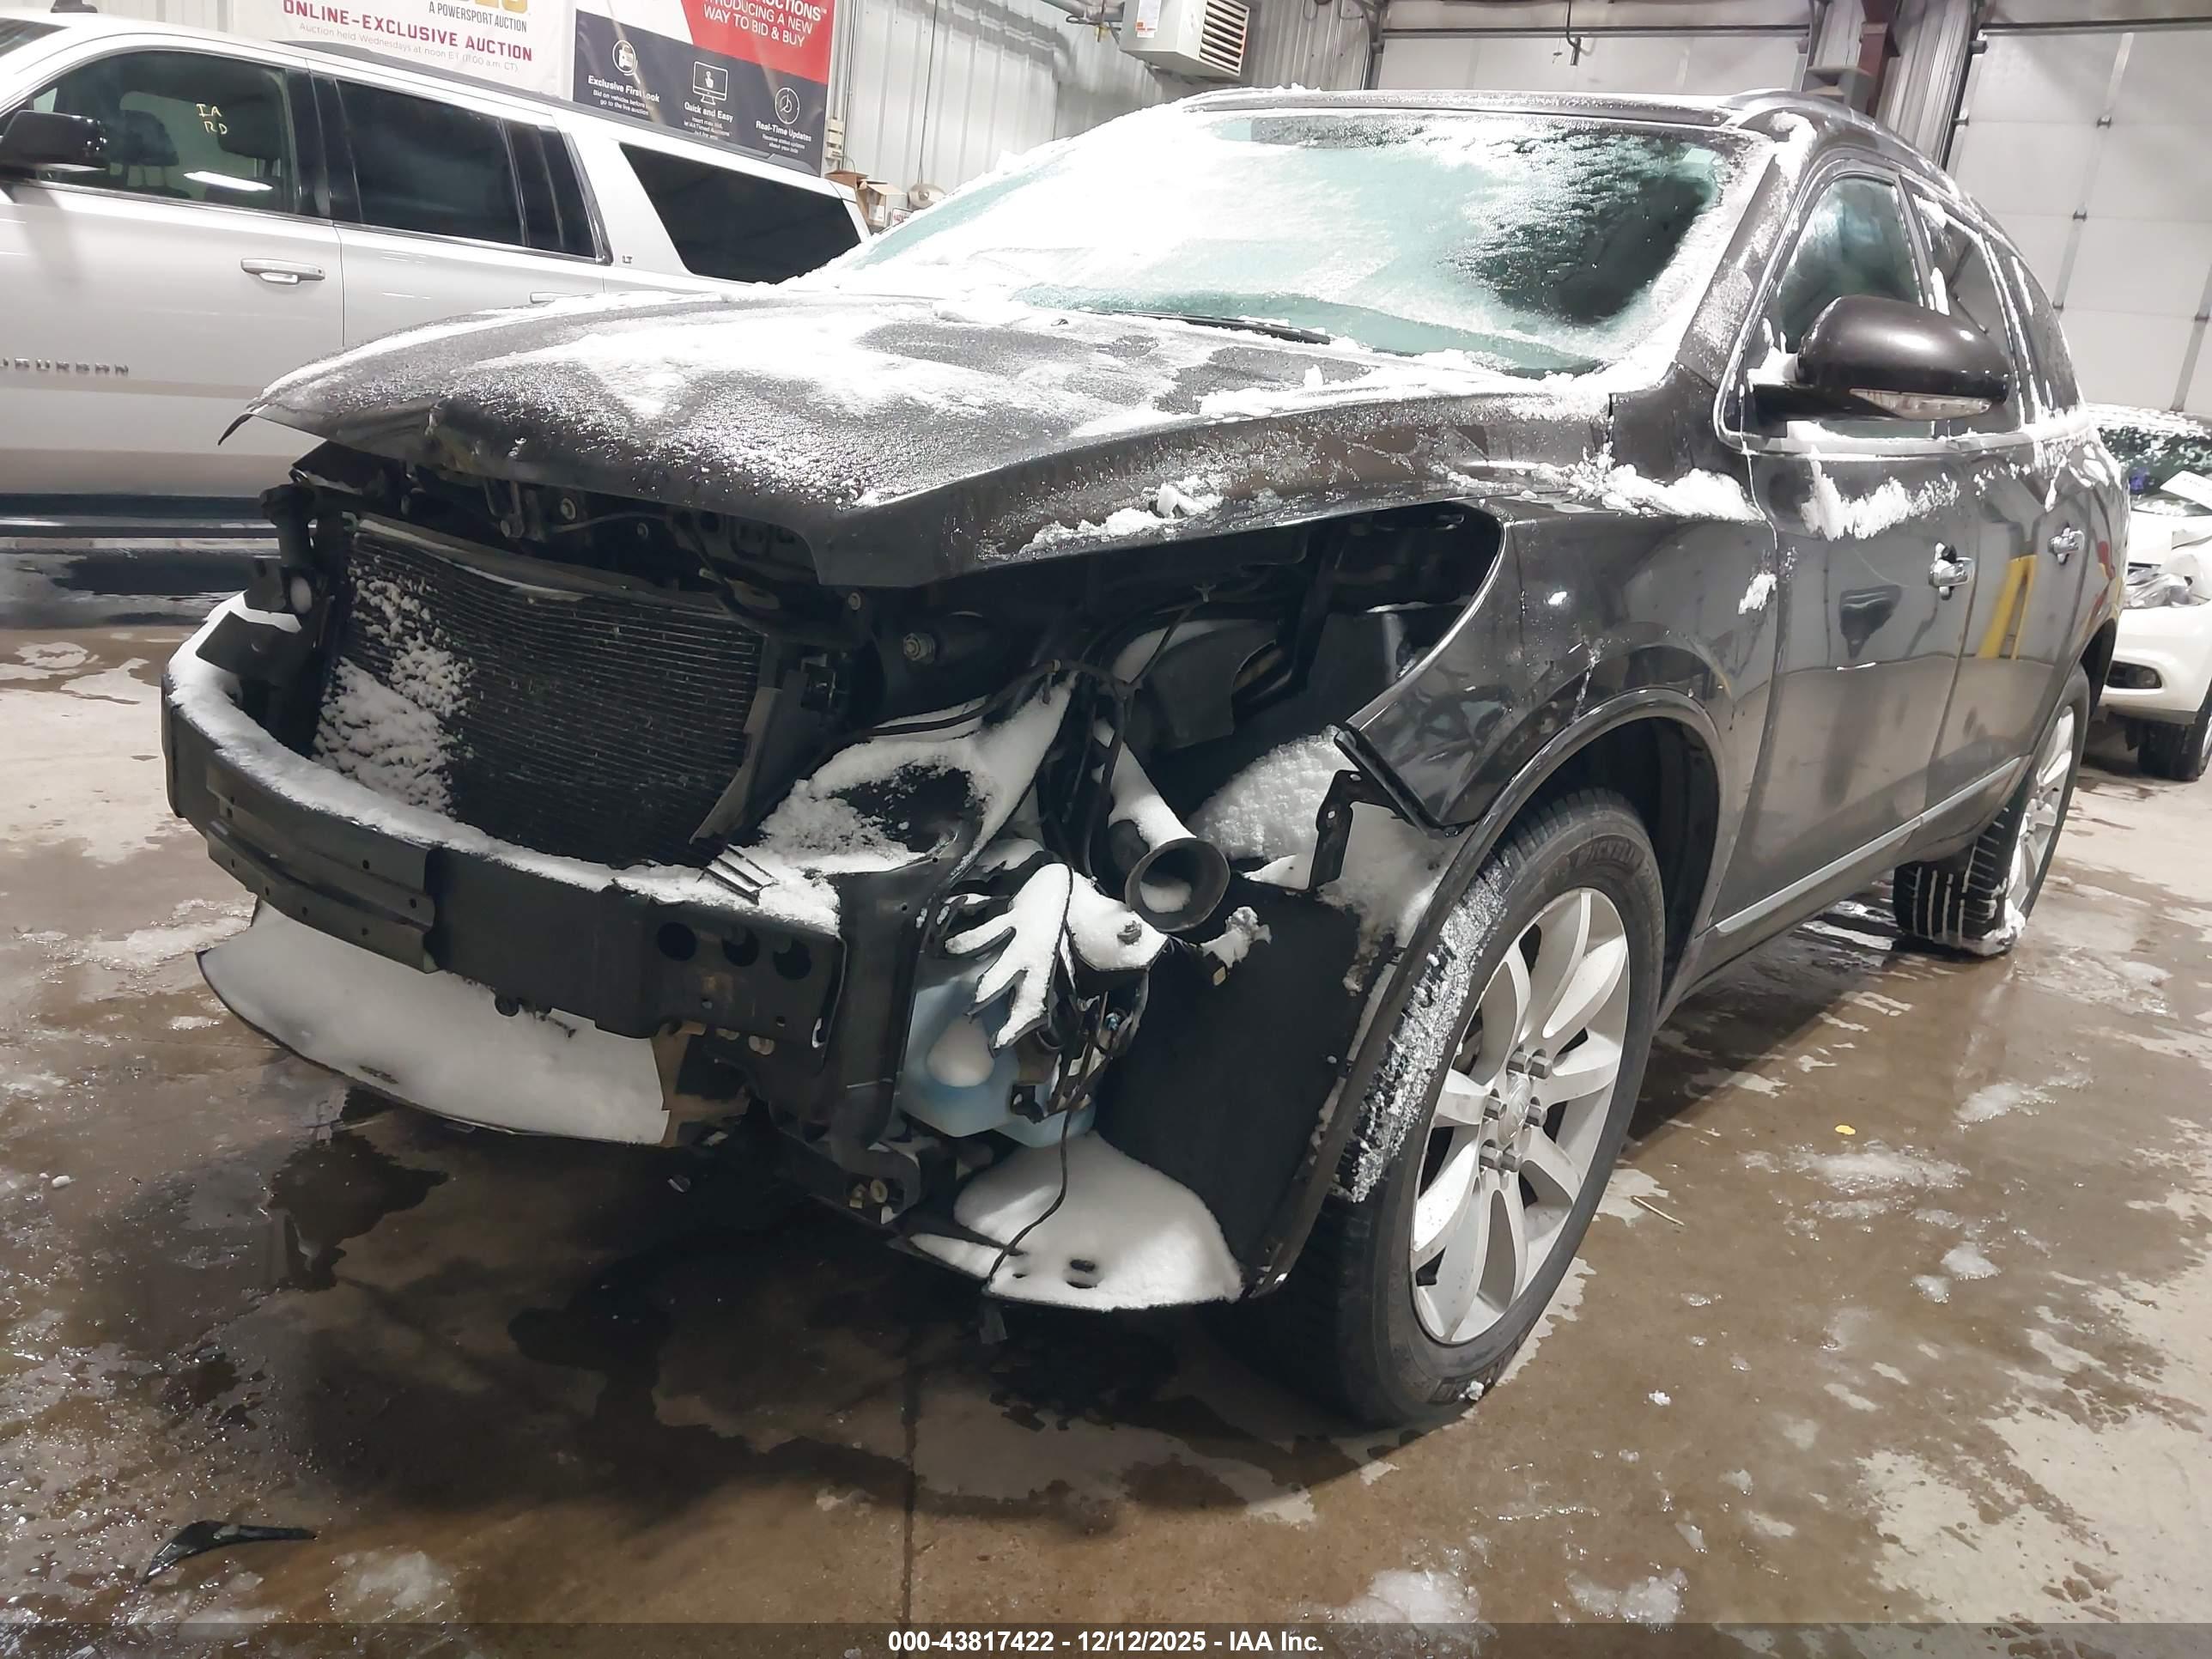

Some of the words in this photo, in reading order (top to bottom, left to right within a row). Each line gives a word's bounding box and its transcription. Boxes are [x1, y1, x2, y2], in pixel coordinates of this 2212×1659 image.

[429, 1, 435, 14] A
[438, 3, 493, 25] POWERSPORT
[495, 15, 527, 33] AUCTION
[704, 4, 731, 24] WAY
[733, 13, 749, 29] TO
[752, 20, 769, 36] BID
[771, 27, 779, 40] &
[782, 30, 805, 47] BUY
[777, 13, 785, 26] A
[788, 16, 813, 34] NEW
[283, 0, 458, 47] ONLINE-EXCLUSIVE
[465, 35, 532, 61] AUCTION
[299, 22, 334, 37] Auction
[337, 29, 356, 41] held
[359, 34, 411, 52] Wednesdays
[413, 46, 421, 54] at
[424, 48, 446, 58] noon
[448, 52, 459, 60] ET
[587, 75, 624, 93] Exclusive
[625, 84, 641, 97] First
[684, 101, 702, 114] Quick
[703, 108, 715, 118] and
[717, 111, 733, 123] Easy
[756, 120, 787, 136] Real-Time
[788, 128, 811, 142] Updates
[0, 357, 129, 376] UBURBAN
